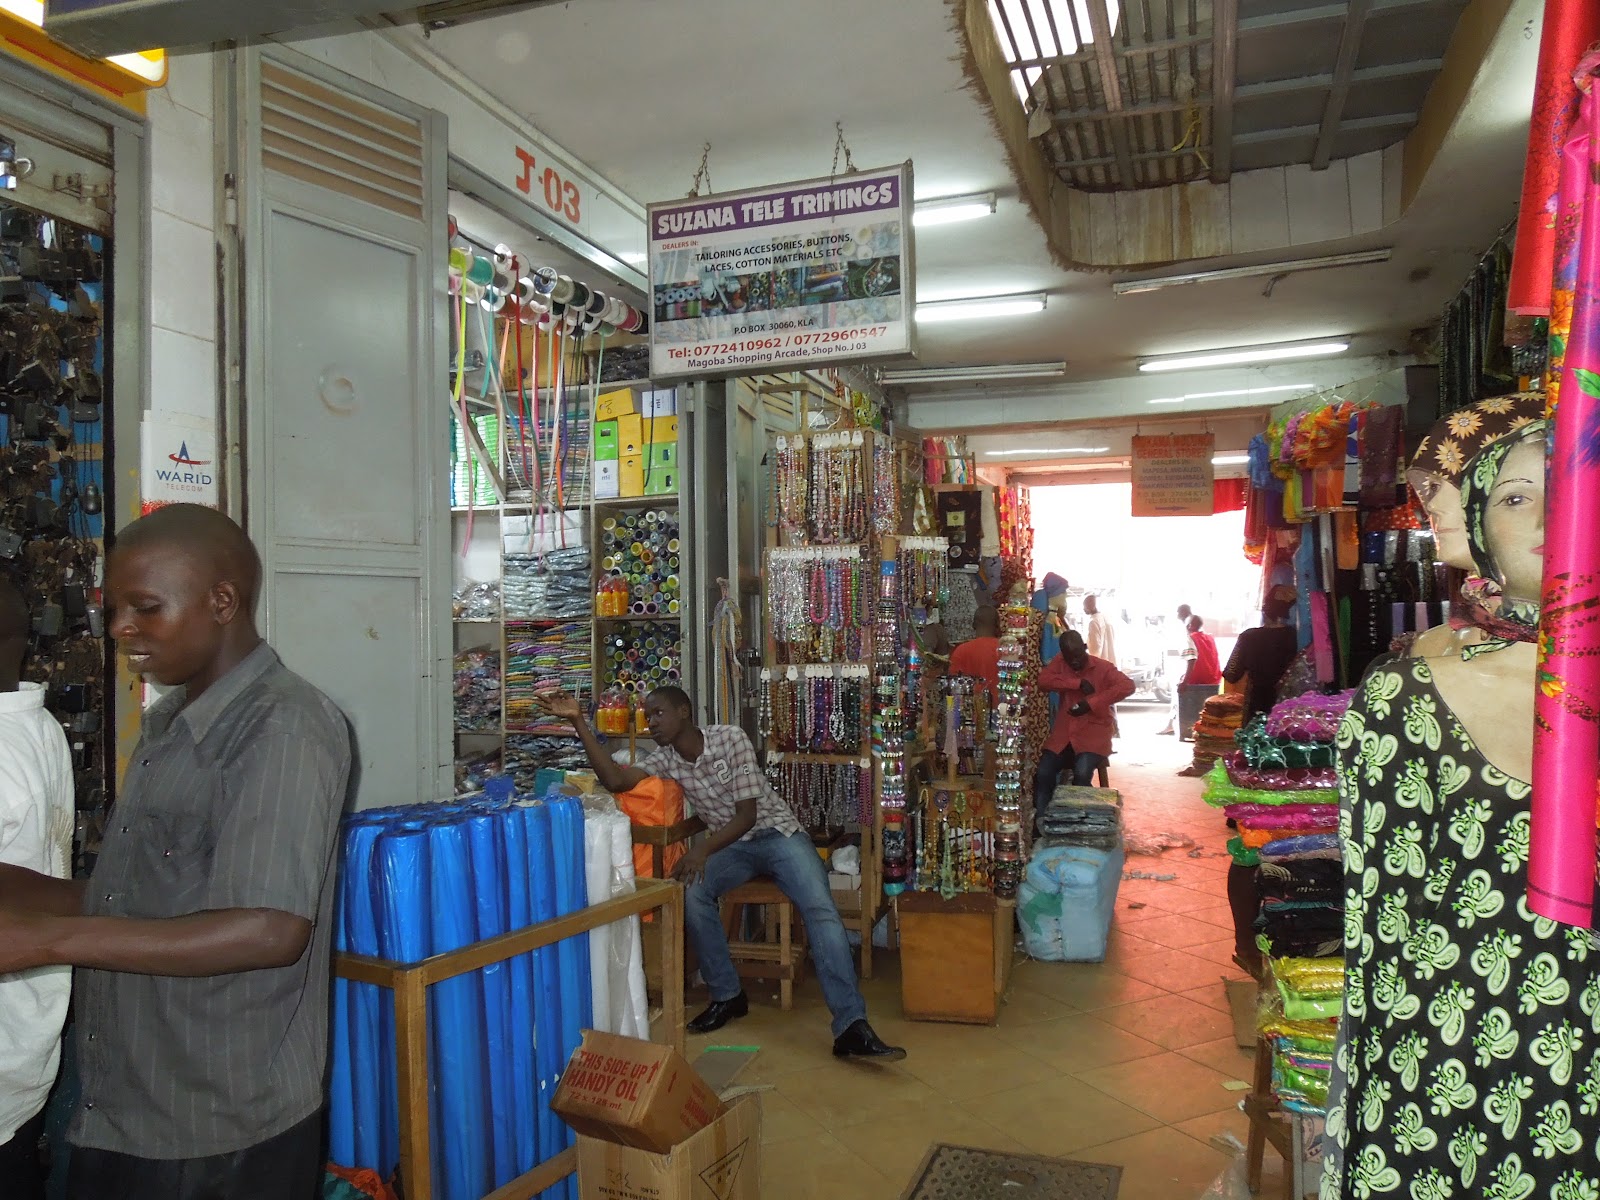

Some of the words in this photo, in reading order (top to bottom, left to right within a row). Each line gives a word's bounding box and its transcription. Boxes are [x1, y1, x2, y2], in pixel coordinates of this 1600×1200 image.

[657, 206, 736, 235] SUZANA
[741, 199, 785, 223] TELE
[791, 182, 893, 217] TRIMINGS
[662, 241, 689, 250] DEALERS
[695, 248, 742, 262] TAILORING
[743, 239, 805, 253] ACCESSORIES,
[807, 234, 853, 248] BUTTONS,
[705, 262, 734, 273] LACES,
[735, 257, 772, 269] COTTON
[773, 250, 824, 265] MATERIALS
[826, 247, 843, 256] ETC
[734, 326, 747, 335] P.O
[748, 323, 766, 332] BOX
[769, 319, 797, 331] 30060,
[797, 318, 814, 327] KLA
[668, 347, 691, 359] Tel:
[694, 337, 782, 356] 0772410962
[794, 326, 887, 346] 0772960547
[687, 356, 725, 369] Magoba
[727, 350, 772, 364] Shopping
[774, 346, 811, 359] Arcade,
[811, 344, 833, 355] Shop
[835, 343, 849, 352] No.
[856, 341, 867, 350] 03
[156, 469, 212, 485] WARID
[166, 483, 203, 492] TELECOM
[712, 758, 733, 785] 2
[578, 1050, 604, 1071] THIS
[603, 1056, 631, 1076] SIDE
[630, 1063, 648, 1080] UP
[565, 1068, 616, 1095] HANDY
[615, 1078, 638, 1102] OIL
